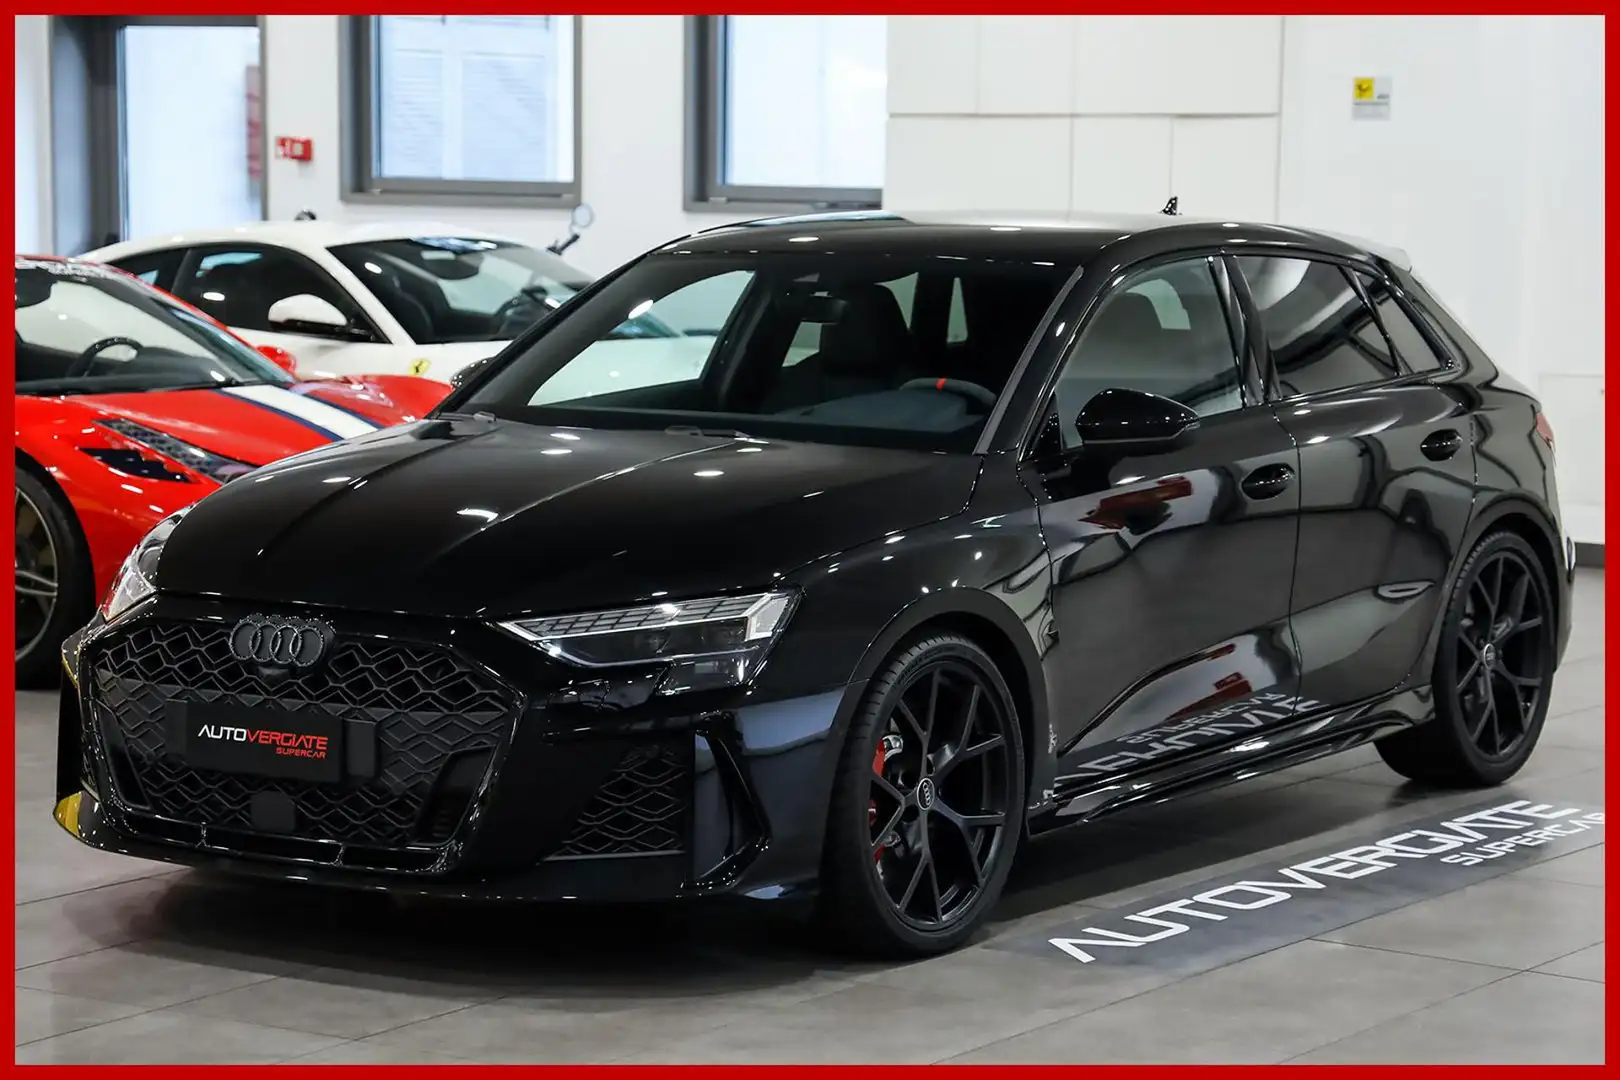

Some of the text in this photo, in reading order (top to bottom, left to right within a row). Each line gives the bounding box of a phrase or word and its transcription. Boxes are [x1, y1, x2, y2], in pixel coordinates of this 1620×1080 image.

[198, 724, 328, 750] AUTOVERGIATE
[275, 747, 326, 759] SUPERCAR
[1049, 800, 1582, 963] AUTOVERGIATE
